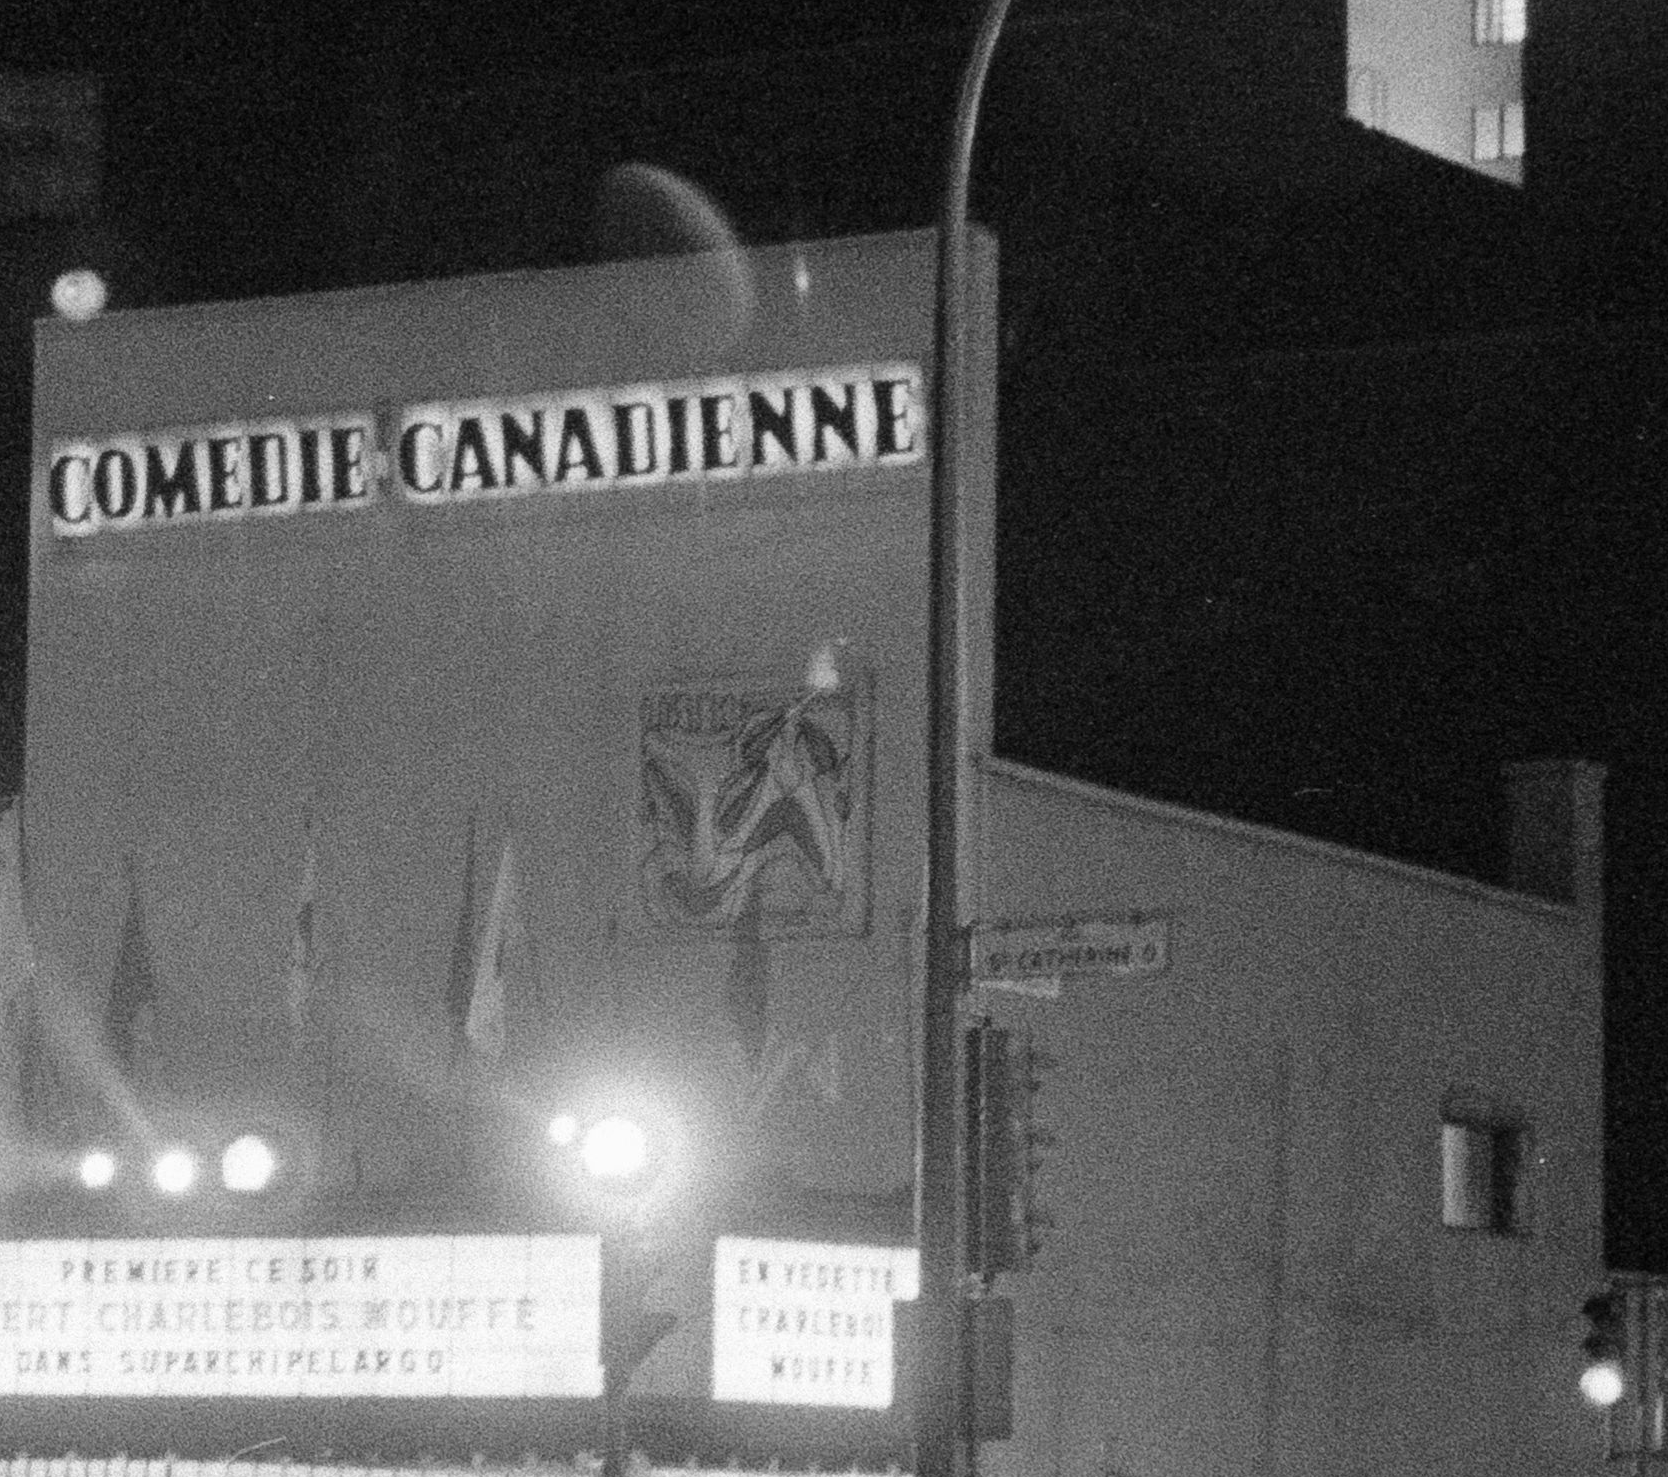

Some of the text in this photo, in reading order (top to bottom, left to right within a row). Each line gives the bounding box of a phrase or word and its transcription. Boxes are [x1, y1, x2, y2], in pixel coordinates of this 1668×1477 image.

[48, 378, 916, 524] COMEDIE CANADIENNE
[60, 1257, 379, 1285] PREMIERE CE SOIR
[739, 1258, 769, 1286] EN
[97, 1300, 341, 1334] CHARLEBOIS
[363, 1297, 536, 1333] MOUFFE
[16, 1348, 444, 1375] DANS SUPARCHIPELARGO
